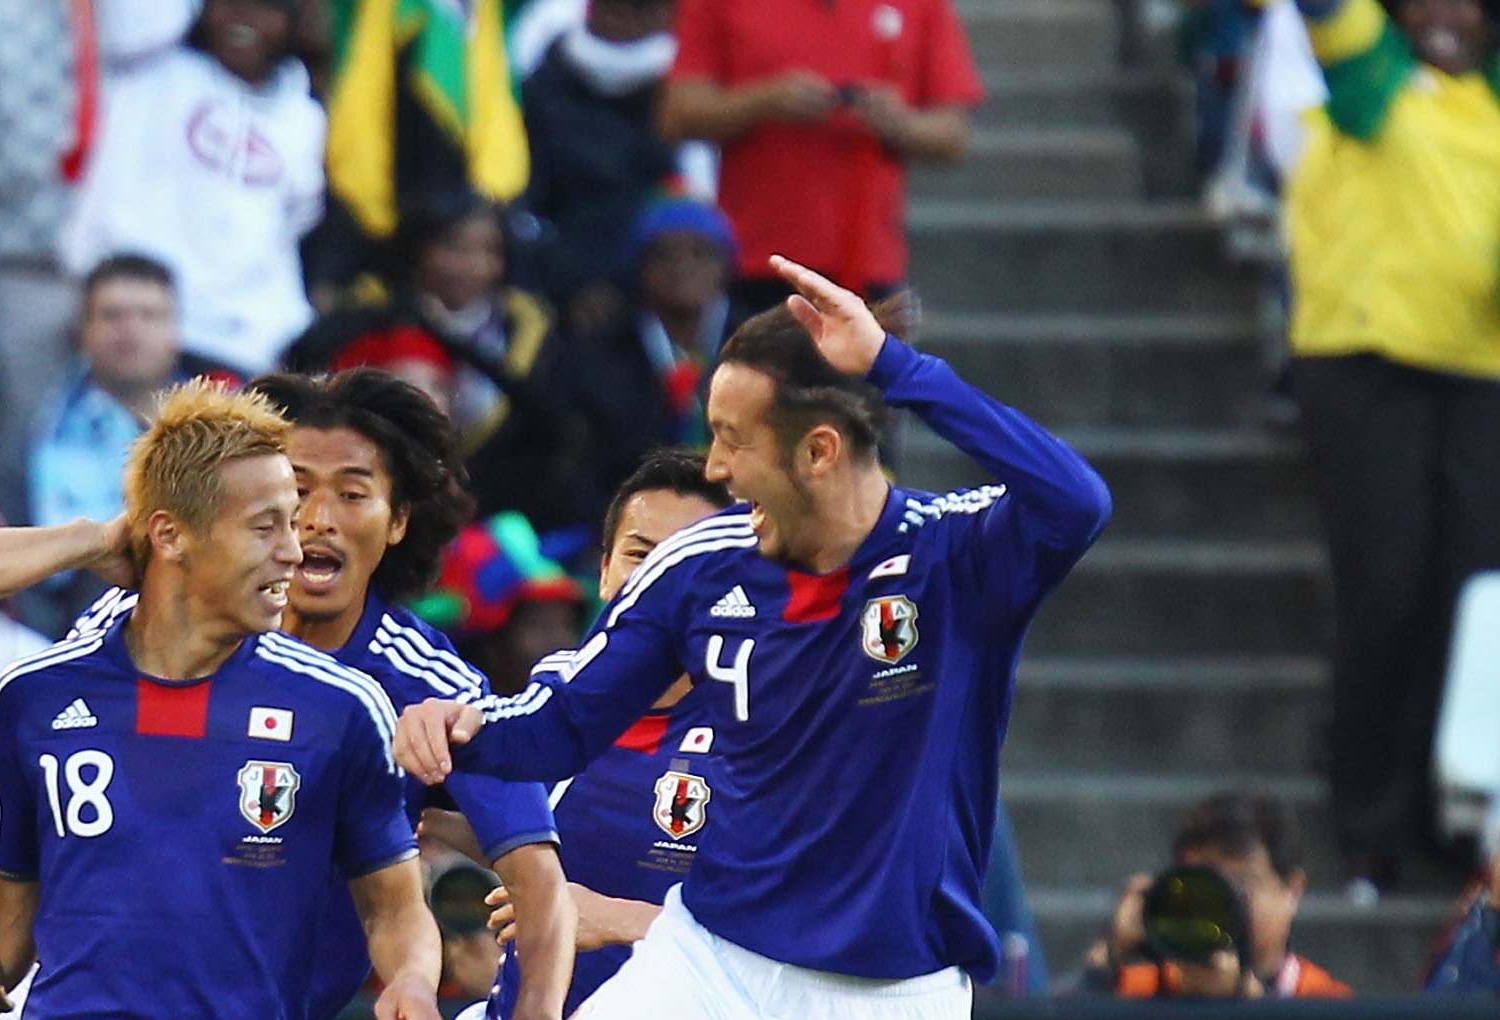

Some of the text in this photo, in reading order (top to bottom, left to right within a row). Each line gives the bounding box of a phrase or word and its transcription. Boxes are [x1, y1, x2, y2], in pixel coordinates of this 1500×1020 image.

[710, 605, 756, 617] adidas
[706, 634, 755, 722] 4
[873, 664, 917, 678] JAPAN
[52, 715, 97, 730] adidas
[39, 749, 114, 838] 18
[242, 835, 283, 844] JAPAN
[653, 841, 697, 852] JAPAN
